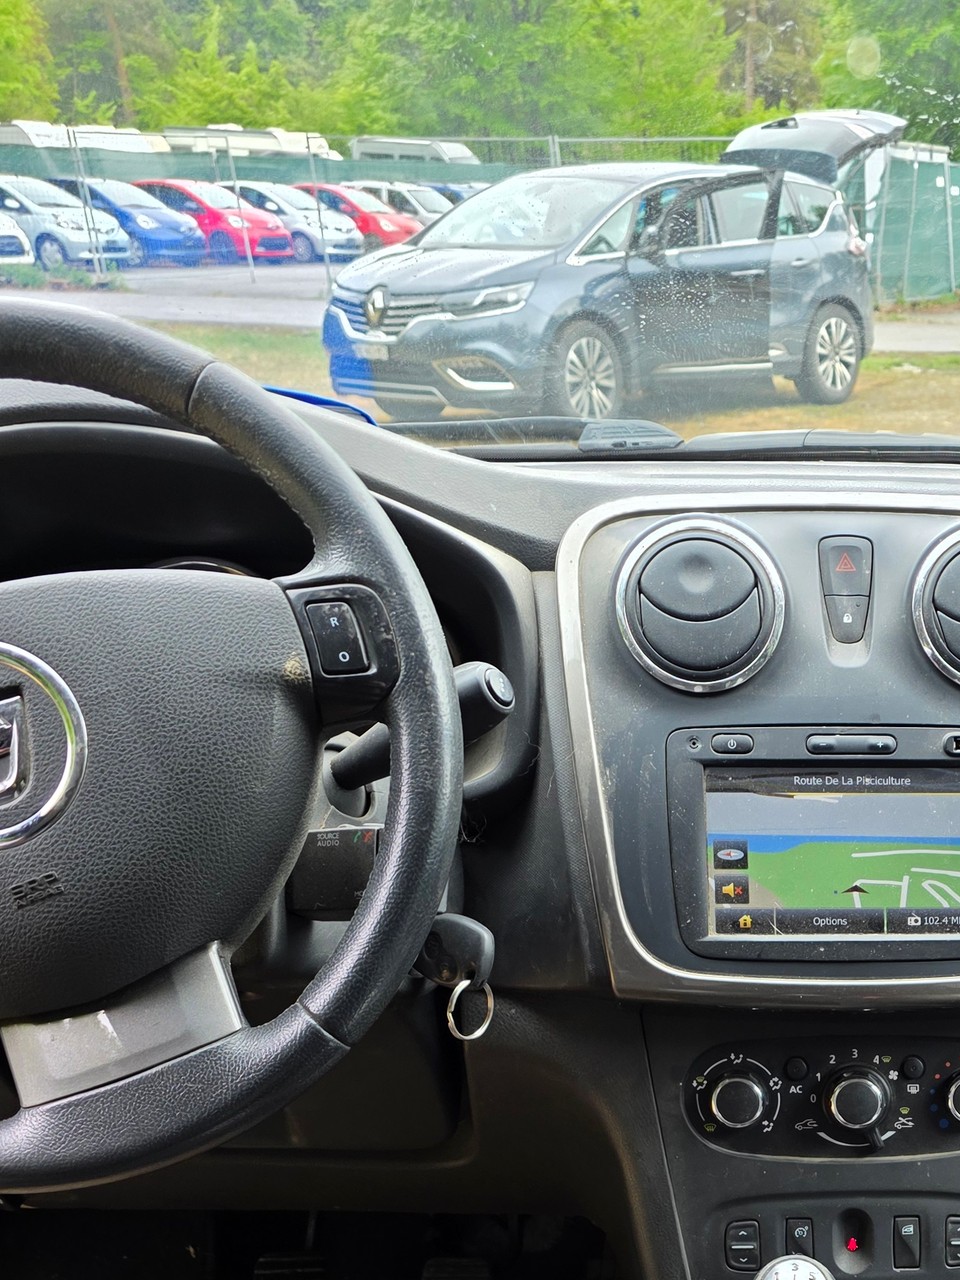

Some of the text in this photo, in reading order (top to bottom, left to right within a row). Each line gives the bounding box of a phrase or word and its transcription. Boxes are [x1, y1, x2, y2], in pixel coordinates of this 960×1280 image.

[330, 617, 340, 627] R
[793, 776, 911, 786] Route De La Pisciculture
[316, 832, 340, 840] SOURCE
[316, 839, 340, 848] AUDIO
[812, 916, 848, 927] Options
[923, 916, 949, 925] 102.4
[851, 1048, 858, 1058] 3
[829, 1054, 836, 1064] 2
[873, 1055, 880, 1064] 4
[815, 1072, 821, 1082] 1
[789, 1085, 803, 1094] AC
[791, 1262, 799, 1272] 3
[774, 1271, 780, 1280] 1
